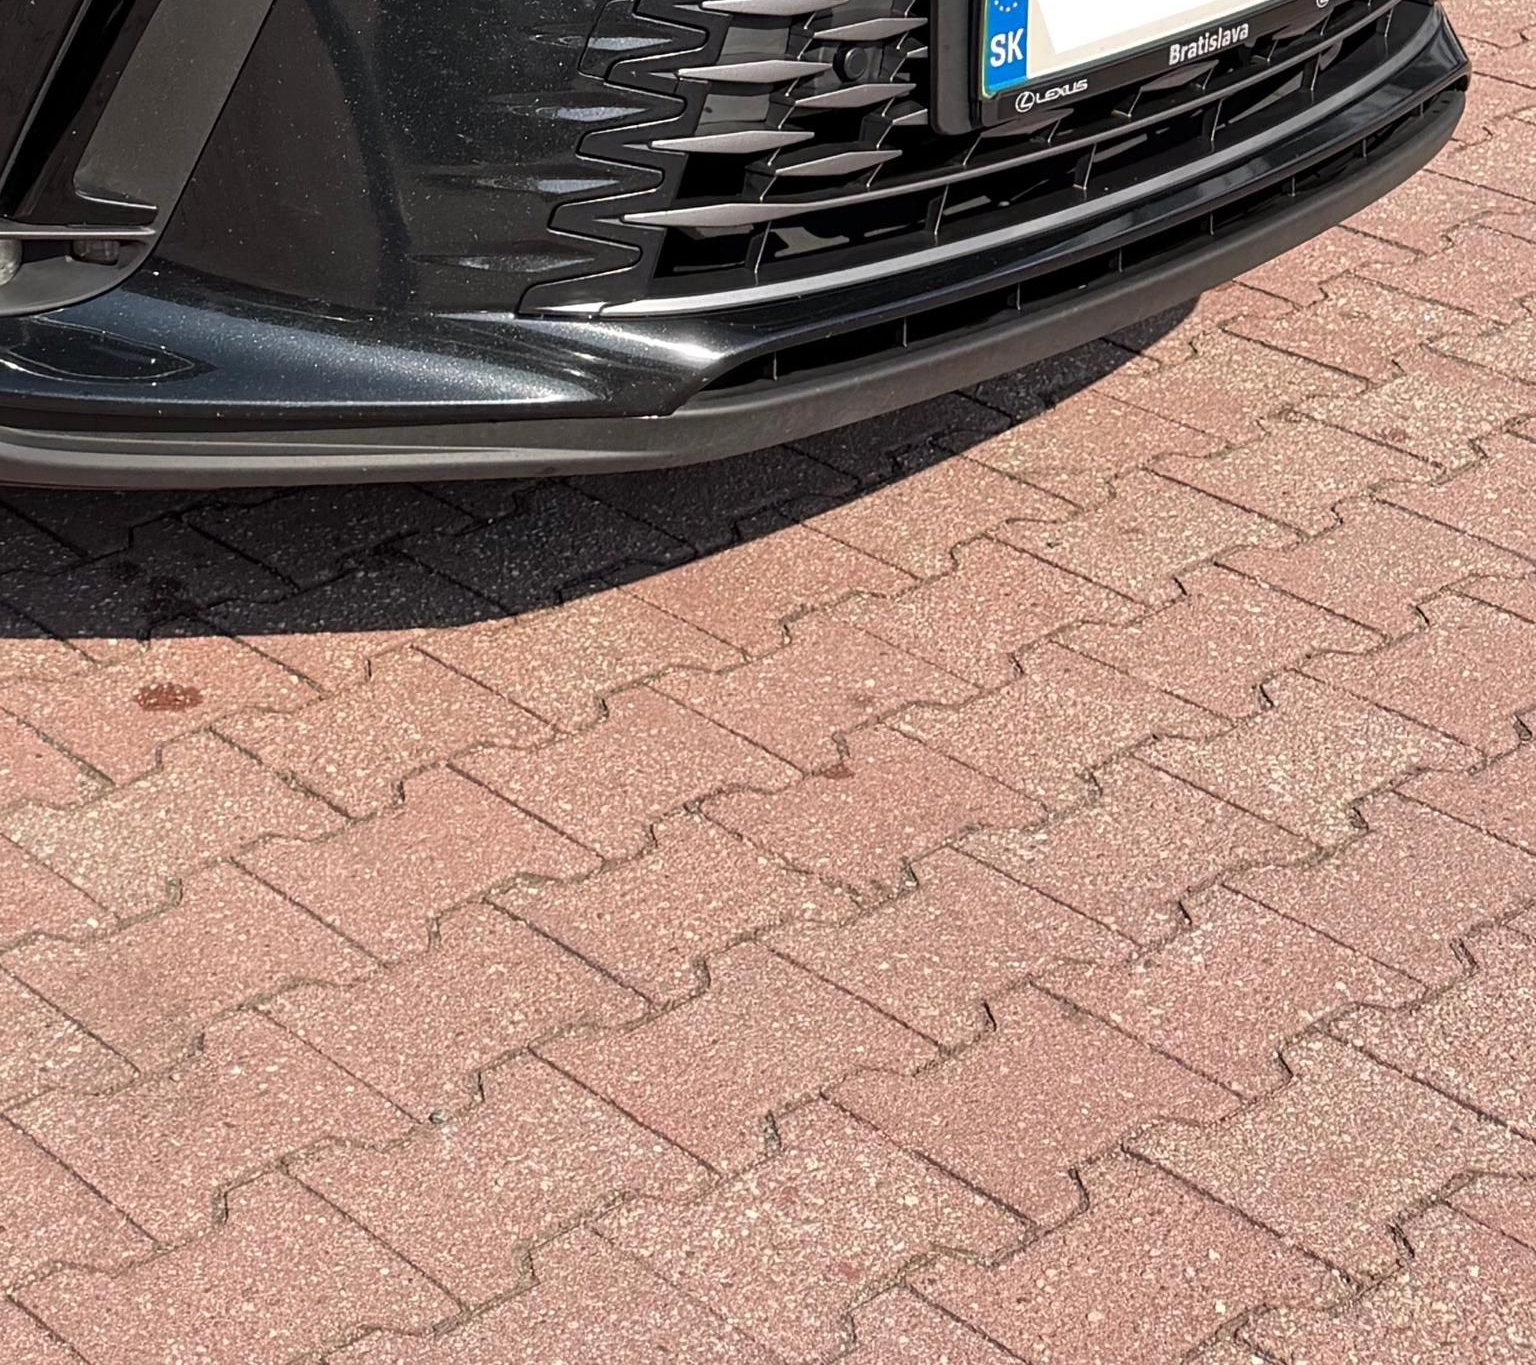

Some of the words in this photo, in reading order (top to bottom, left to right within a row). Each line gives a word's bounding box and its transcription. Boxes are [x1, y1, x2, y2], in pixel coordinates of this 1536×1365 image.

[989, 27, 1025, 68] SK
[1168, 22, 1250, 66] Bratislava
[1035, 79, 1089, 104] LEXUS
